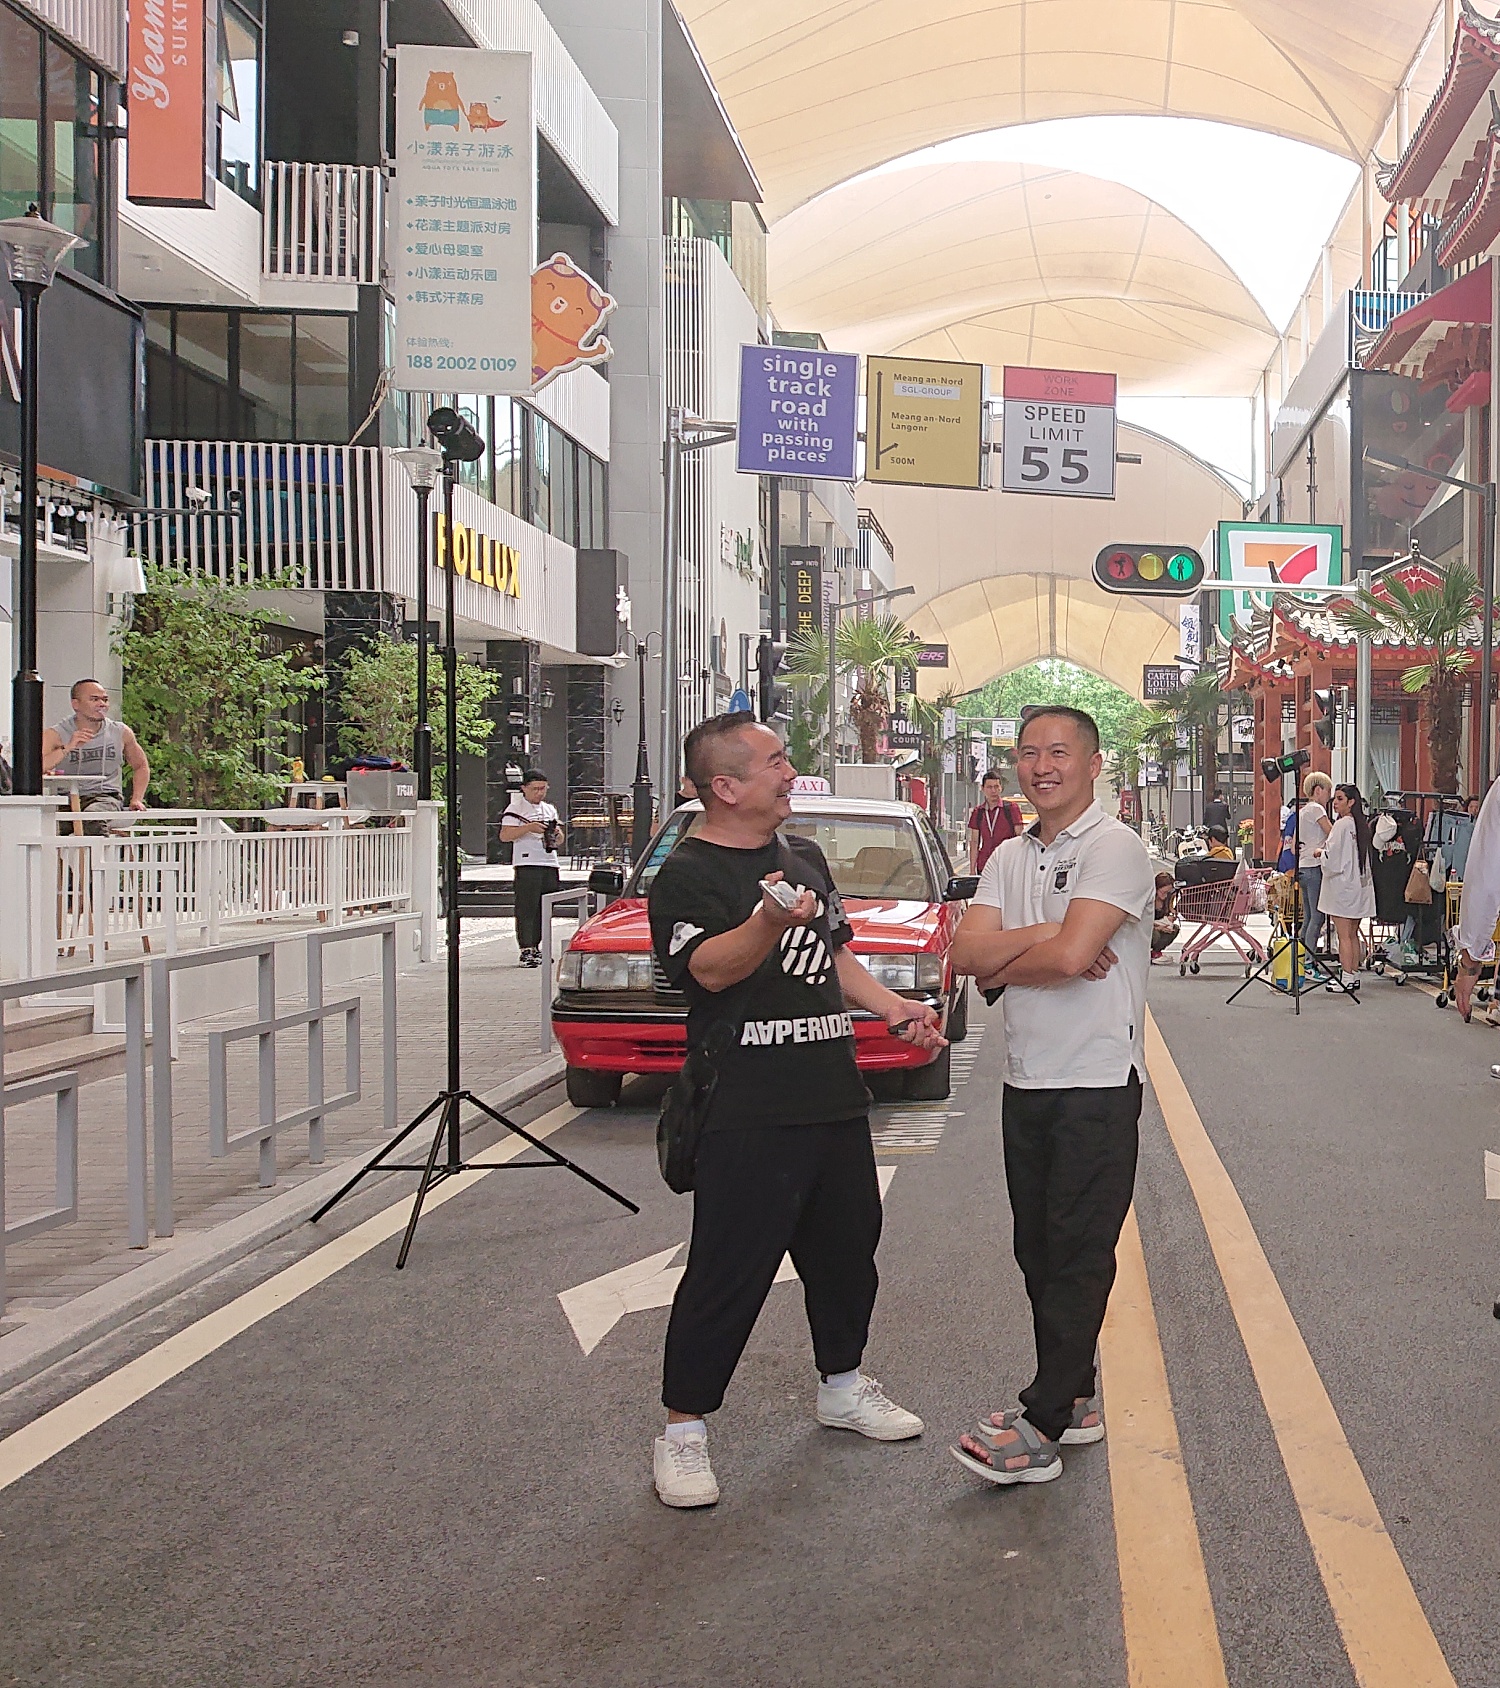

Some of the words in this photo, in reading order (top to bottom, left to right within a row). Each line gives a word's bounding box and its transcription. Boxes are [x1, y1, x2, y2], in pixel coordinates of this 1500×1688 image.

[415, 267, 498, 282] 小漾运动乐园
[406, 355, 433, 369] 188
[437, 356, 477, 371] 2002
[480, 357, 517, 372] 0109
[763, 354, 838, 380] single
[767, 376, 832, 398] track
[1044, 375, 1079, 385] WORK
[1044, 387, 1075, 396] ZONE
[770, 399, 827, 417] road
[1024, 405, 1086, 424] SPEED
[777, 416, 819, 432] with
[762, 432, 833, 452] passing
[1030, 426, 1084, 443] LIMIT
[768, 446, 827, 463] places
[890, 457, 915, 466] 500M
[1021, 445, 1089, 485] 55
[798, 569, 812, 603] DEEP
[893, 736, 920, 744] COURT
[790, 780, 824, 792] TAXI
